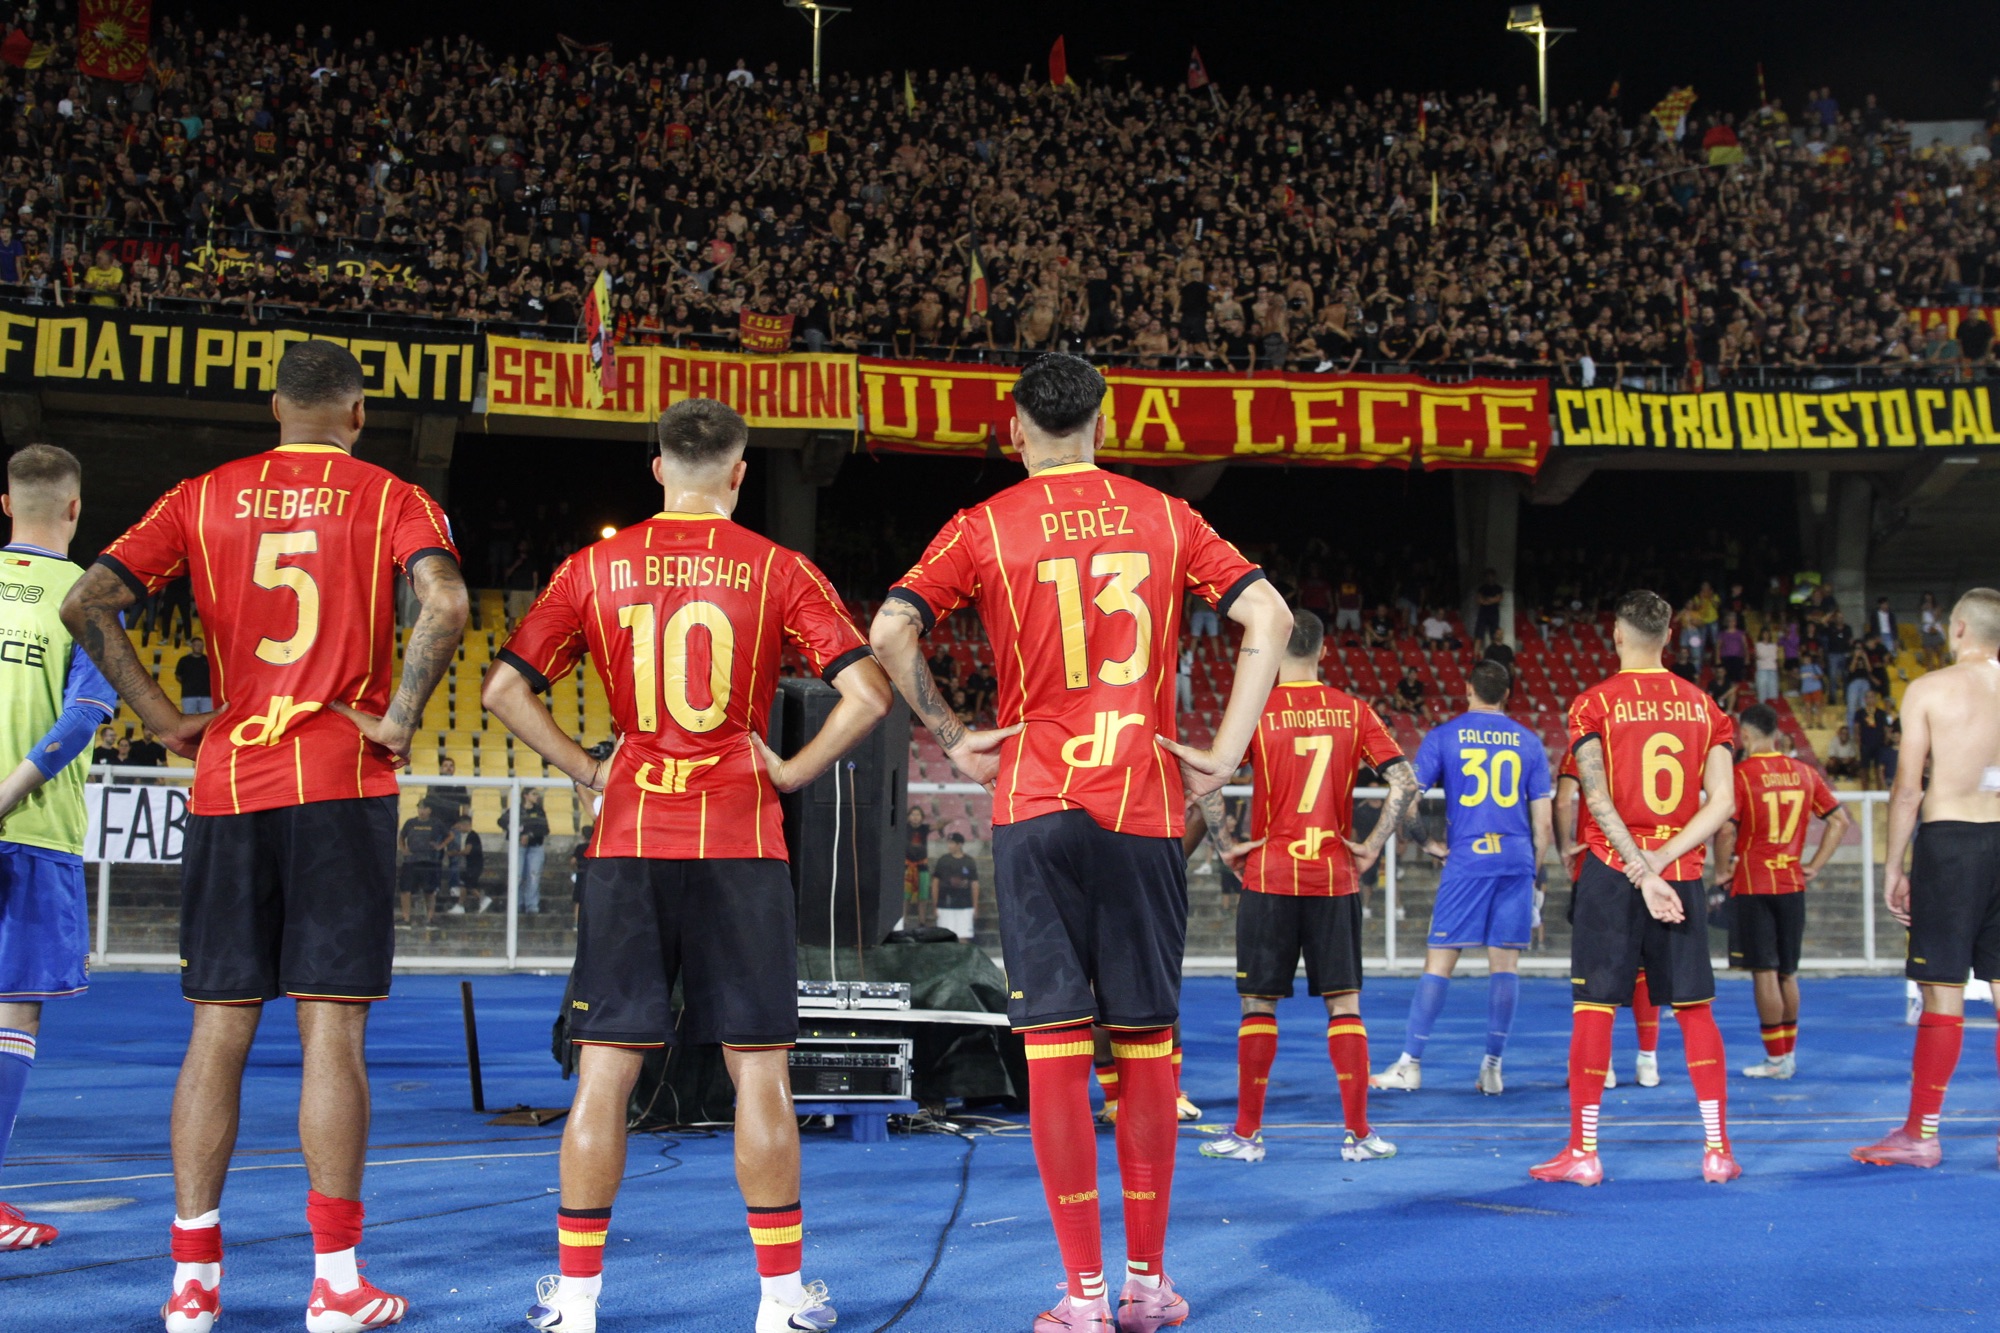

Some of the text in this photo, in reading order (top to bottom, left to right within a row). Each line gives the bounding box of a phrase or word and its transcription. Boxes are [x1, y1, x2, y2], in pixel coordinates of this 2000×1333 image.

[194, 327, 474, 403] PRENTI
[659, 355, 852, 419] PADRONI
[1232, 389, 1538, 458] LECCE
[1555, 387, 1734, 450] CONTRO
[1734, 388, 1917, 451] QUESTO
[235, 487, 351, 520] SIEBERT
[1040, 500, 1134, 542] PERÉZ
[252, 530, 320, 667] 5
[645, 555, 752, 593] BERISHA
[1036, 551, 1153, 690] 13
[617, 600, 735, 733] 10
[1266, 708, 1352, 731] T. MORENTE
[1458, 728, 1521, 747] FALCONE
[1614, 697, 1706, 724] ÁLEX SALA
[1294, 735, 1334, 813] 7
[1459, 748, 1522, 808] 30
[1642, 731, 1685, 816] 6
[1760, 772, 1801, 788] DANILO
[98, 786, 188, 860] FAB
[1762, 790, 1805, 844] 17
